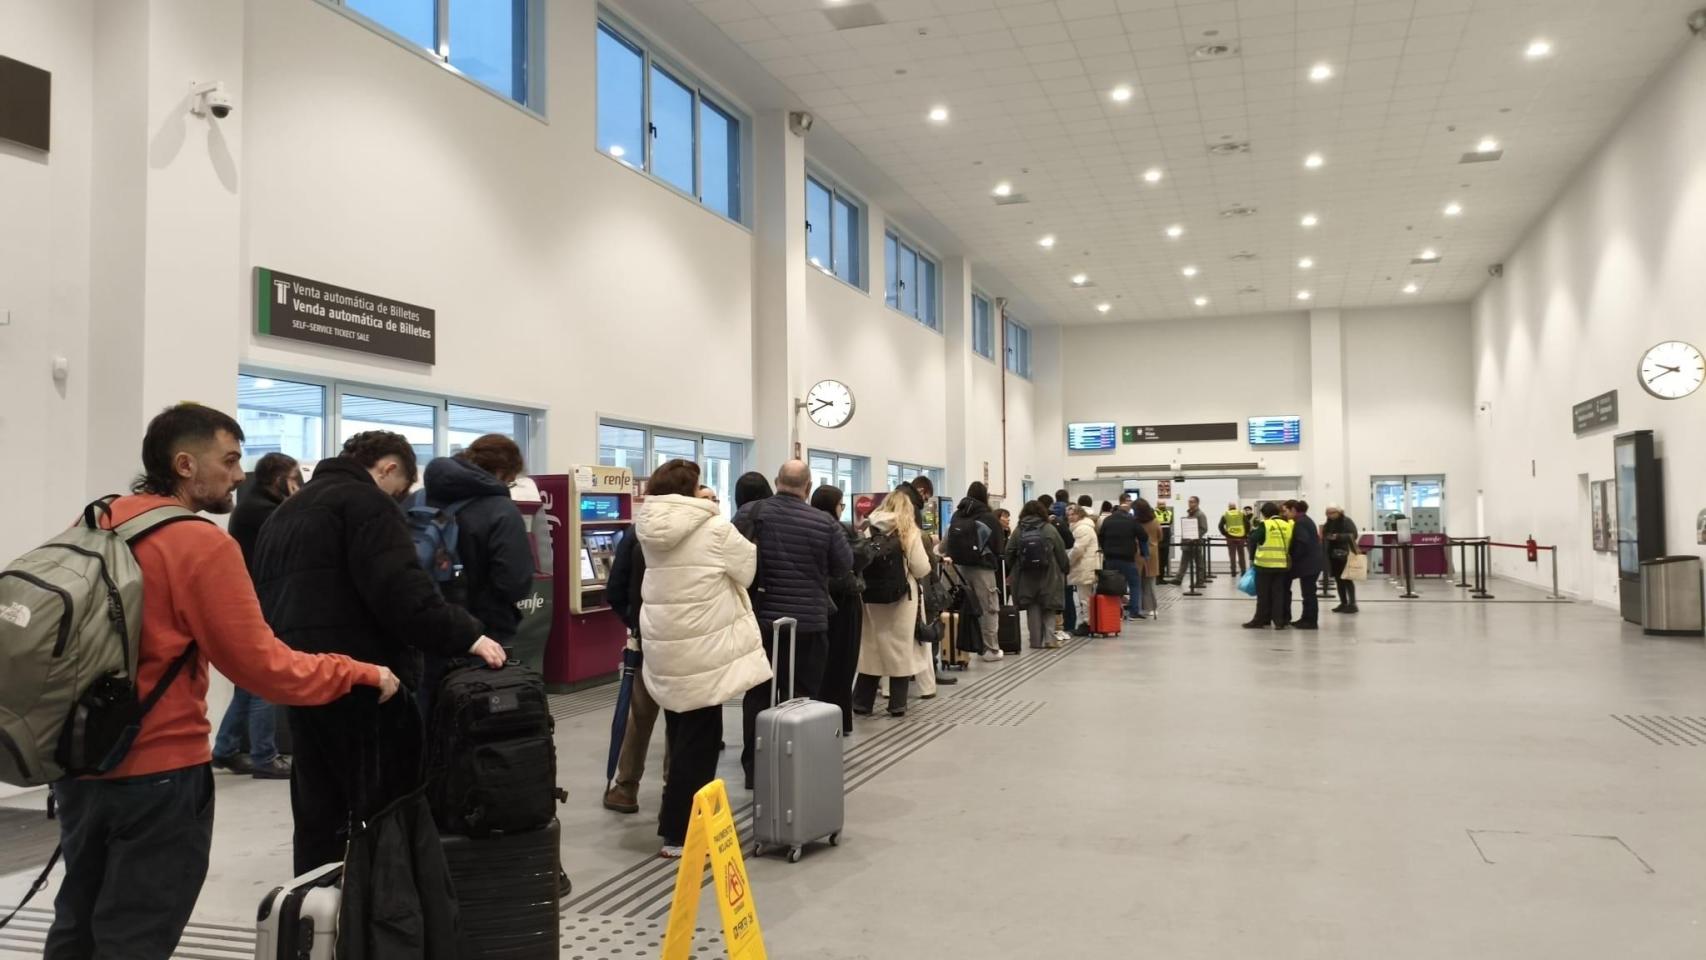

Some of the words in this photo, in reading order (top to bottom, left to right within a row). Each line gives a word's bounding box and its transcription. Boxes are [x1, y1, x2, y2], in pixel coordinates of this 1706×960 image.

[293, 282, 320, 299] Venta
[323, 291, 374, 311] automática
[377, 303, 388, 315] de
[390, 305, 420, 322] Billetes
[293, 298, 325, 317] Venda
[328, 309, 383, 329] automática
[385, 319, 397, 332] de
[400, 321, 431, 339] Billetes
[292, 319, 333, 335] SELF-SERVICE
[356, 332, 370, 342] SALE
[603, 470, 631, 490] renfe
[516, 592, 544, 615] enfe
